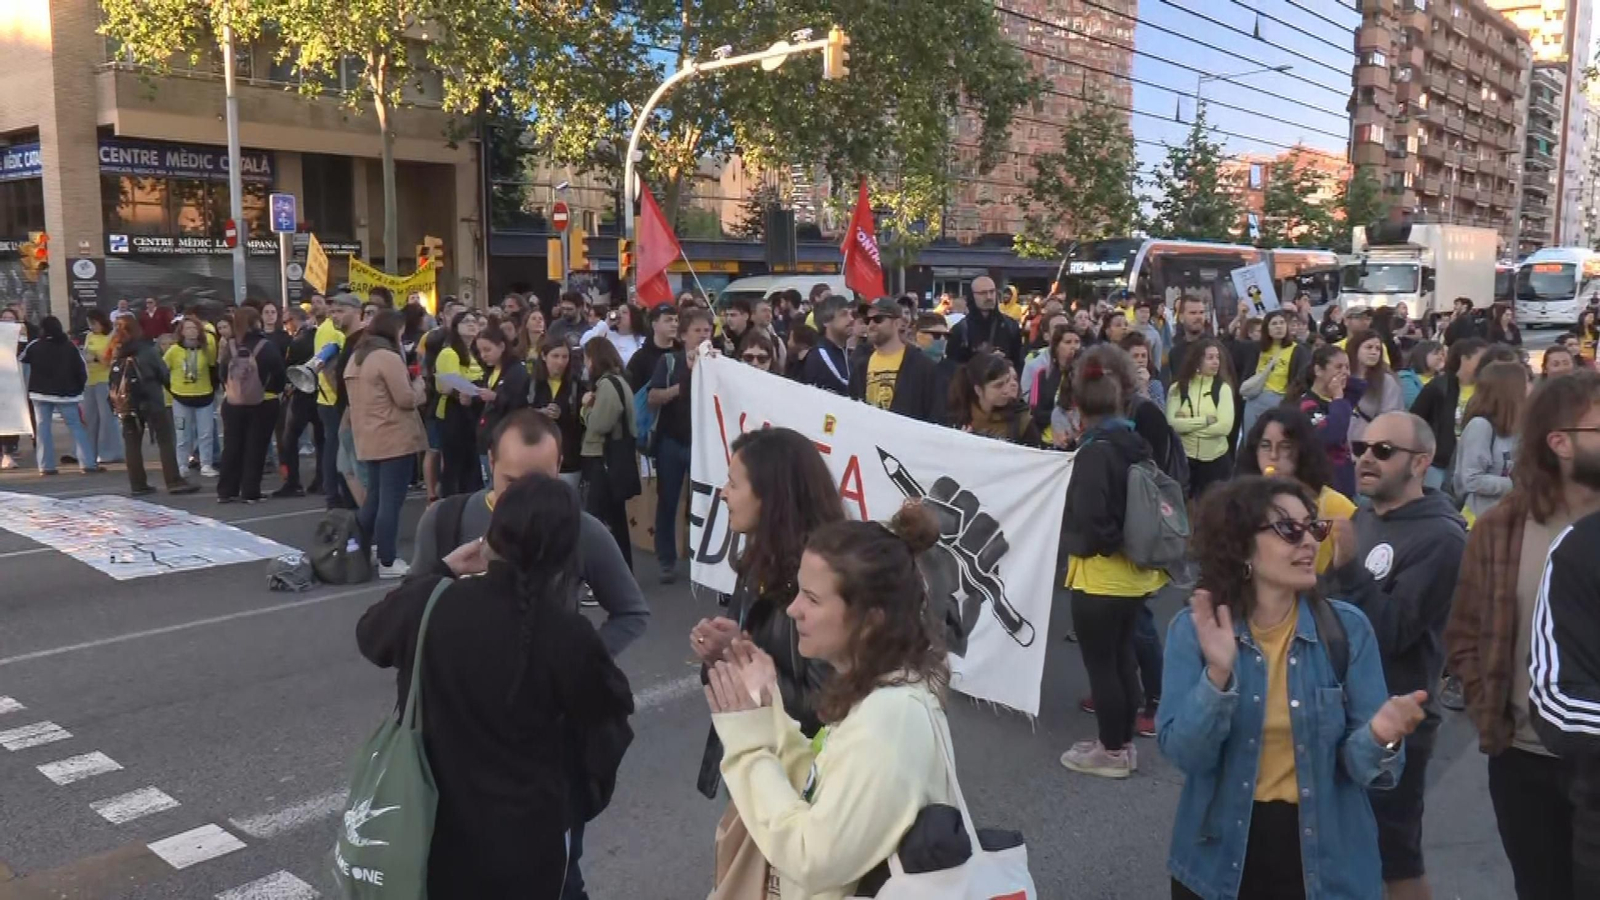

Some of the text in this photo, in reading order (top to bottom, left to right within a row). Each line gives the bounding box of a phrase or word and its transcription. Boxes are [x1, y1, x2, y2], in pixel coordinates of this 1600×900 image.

[99, 146, 159, 166] CENTRE
[166, 149, 213, 170] MÈDIC
[219, 154, 270, 174] CTALÀ
[133, 237, 174, 247] CENTRE
[178, 236, 212, 248] MÈDIC
[215, 239, 229, 248] LA
[352, 867, 385, 886] ONE
